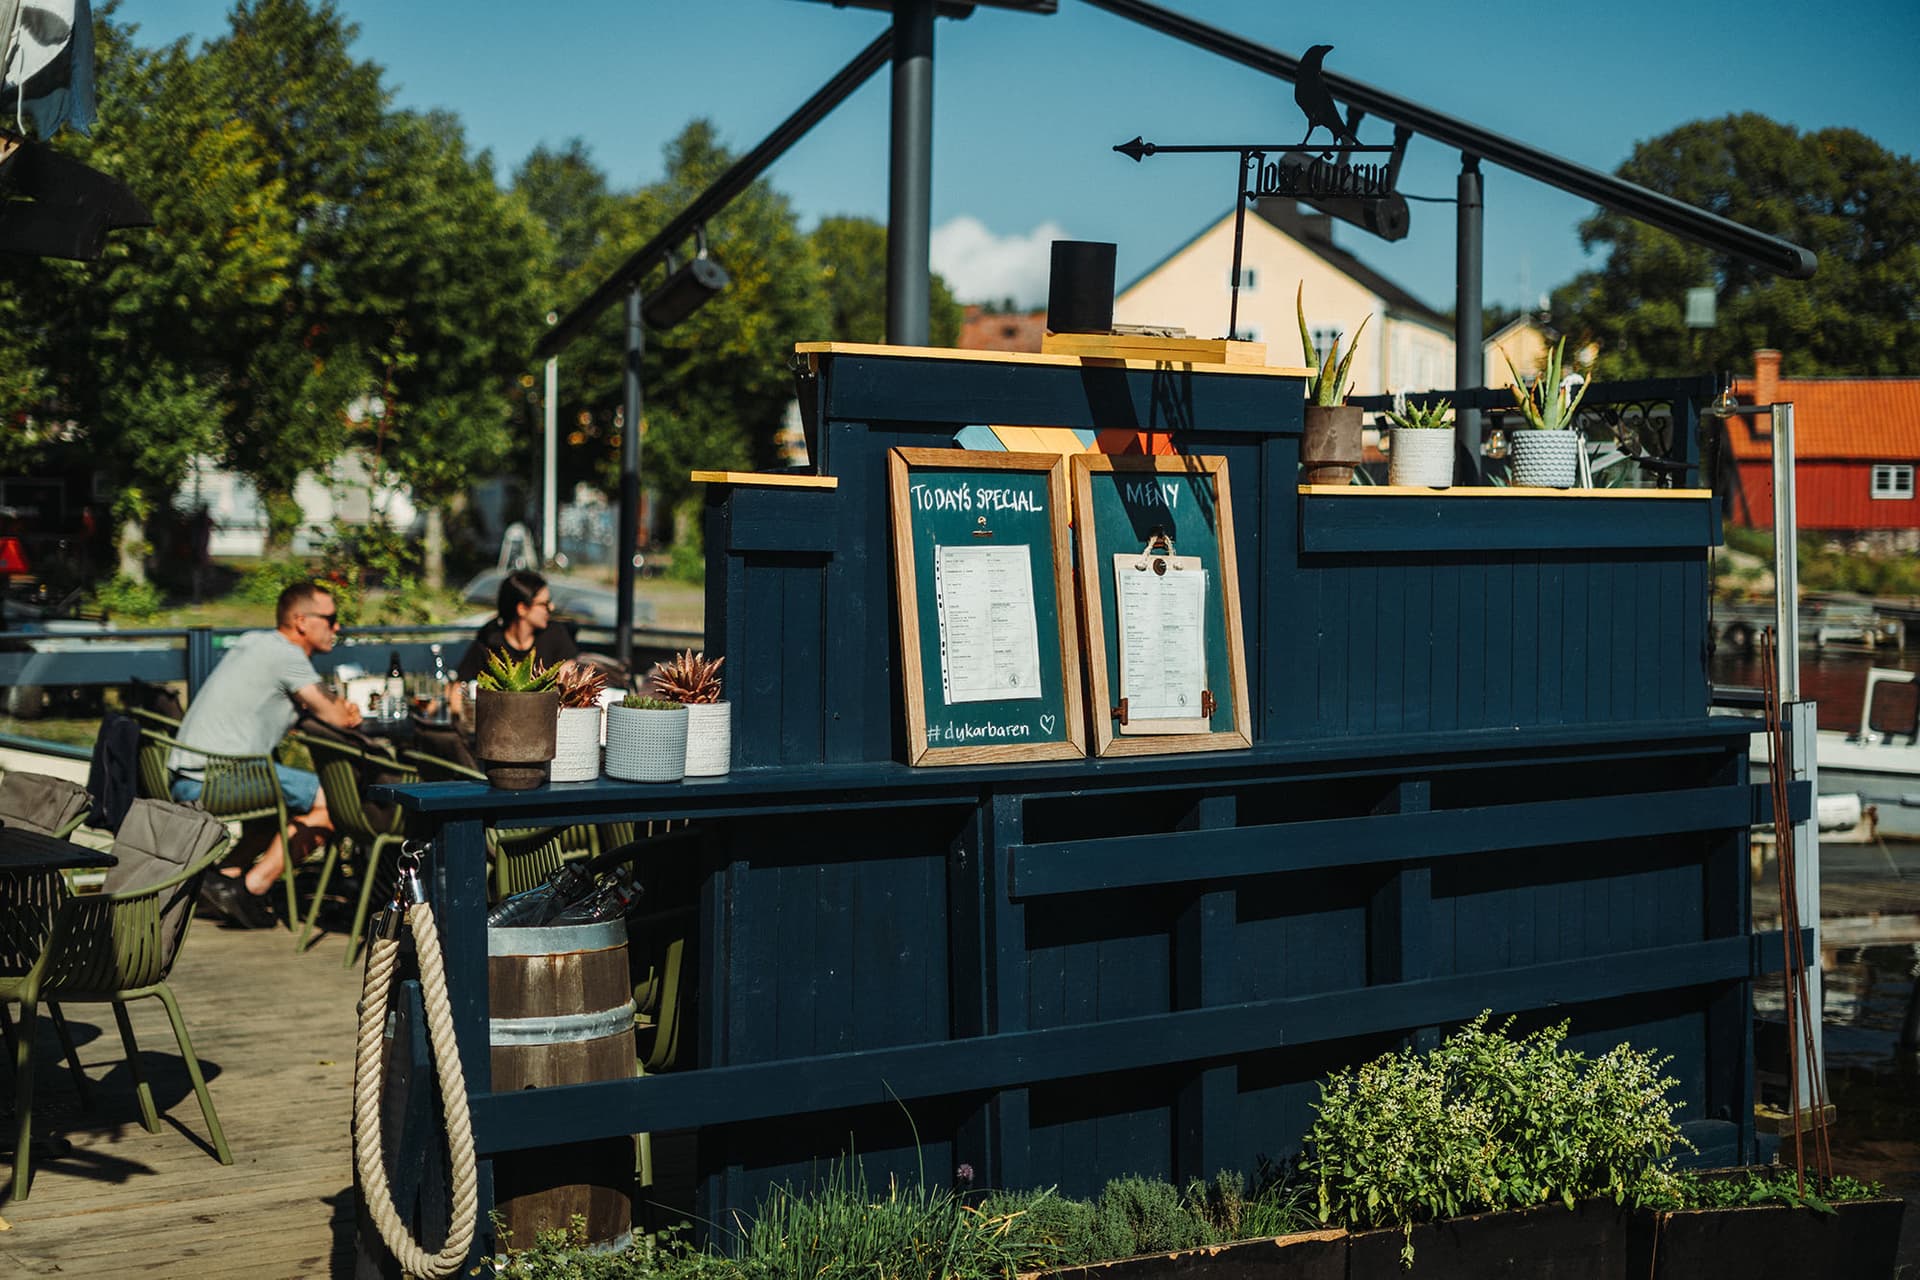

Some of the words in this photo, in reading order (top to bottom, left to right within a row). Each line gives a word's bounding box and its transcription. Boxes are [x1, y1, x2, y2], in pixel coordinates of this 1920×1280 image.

[1308, 152, 1391, 198] Cuervo
[976, 488, 1043, 512] SPECIAL
[1126, 481, 1179, 509] MENY
